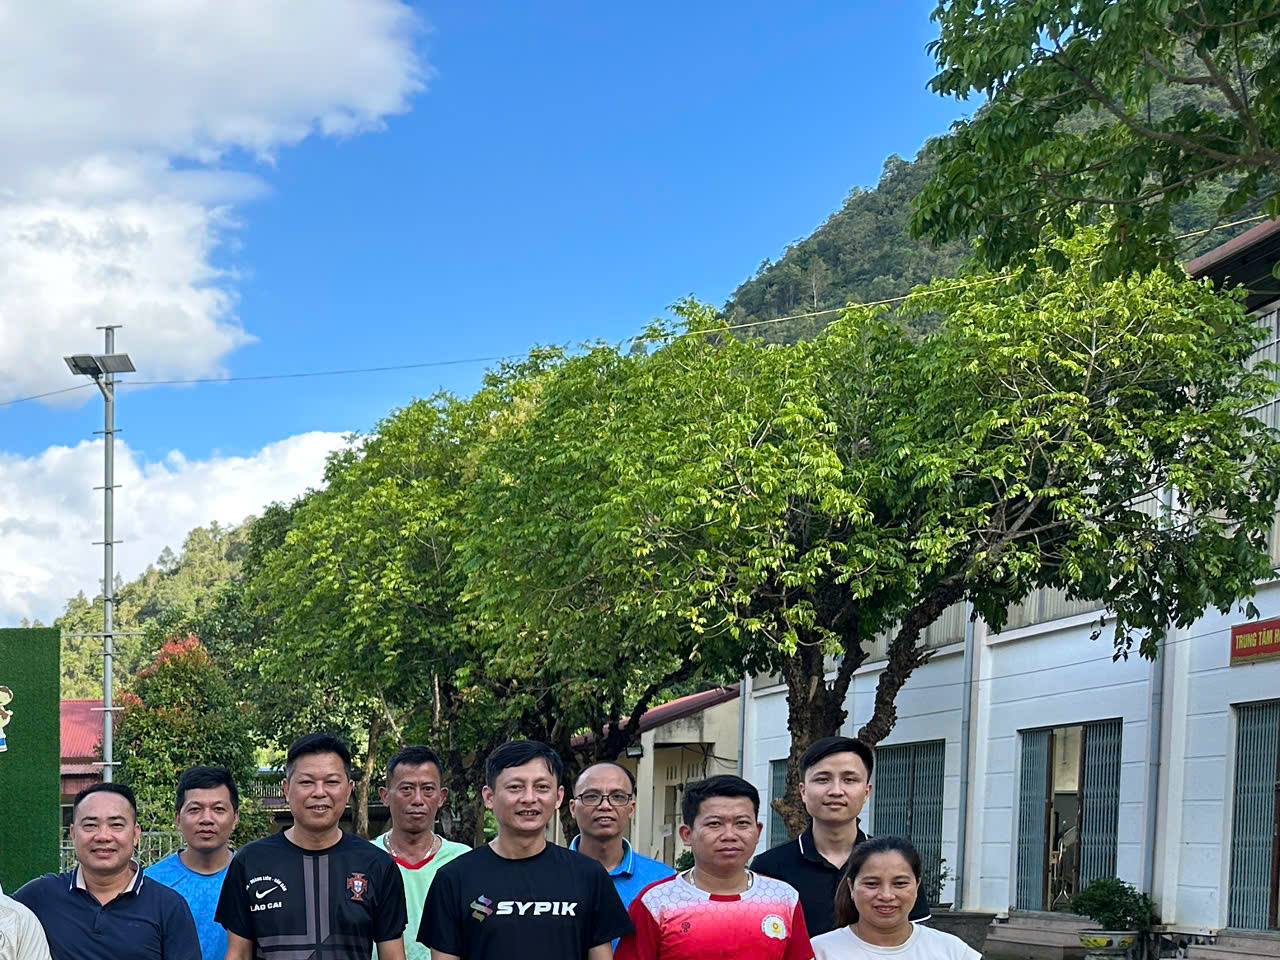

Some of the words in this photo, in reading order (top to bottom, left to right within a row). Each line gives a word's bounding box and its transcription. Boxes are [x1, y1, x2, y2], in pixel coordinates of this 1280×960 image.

[1235, 632, 1257, 649] TRUNG
[267, 901, 282, 909] CAI
[495, 901, 578, 916] SYPIK
